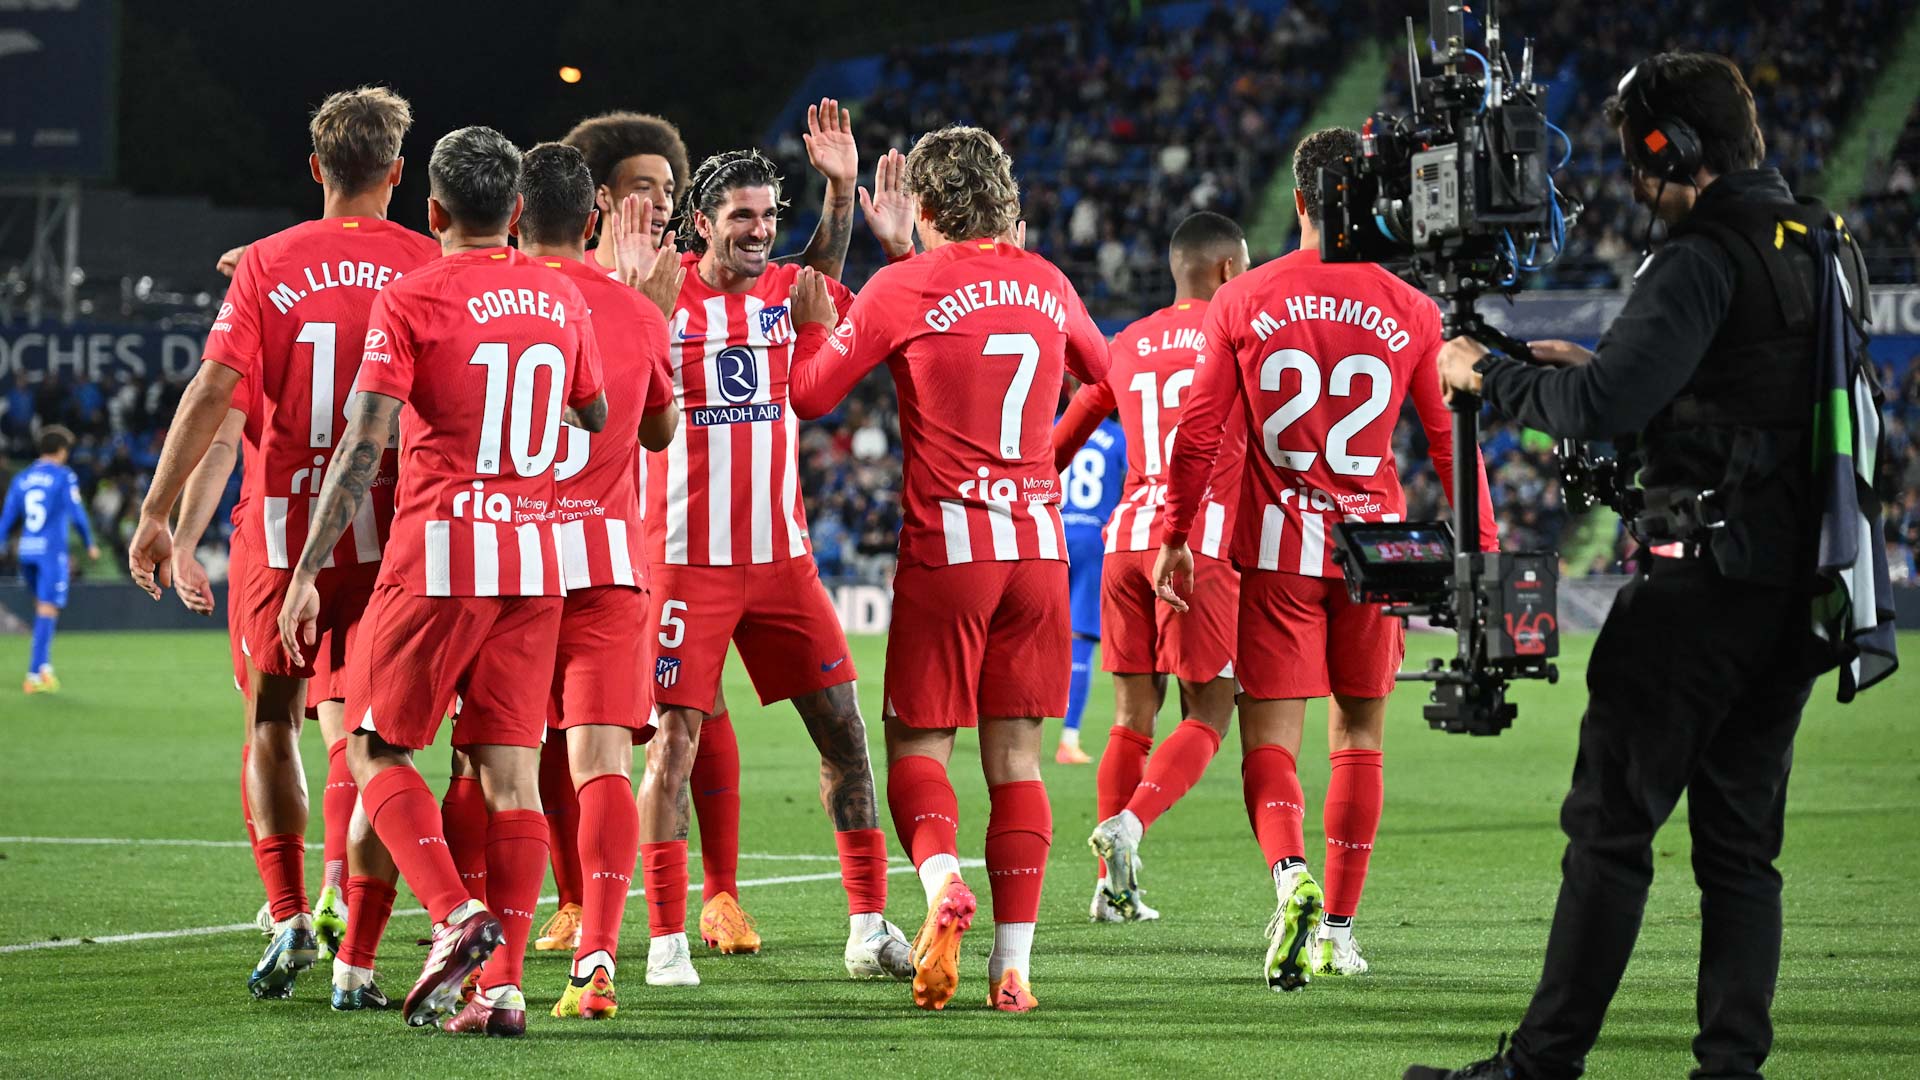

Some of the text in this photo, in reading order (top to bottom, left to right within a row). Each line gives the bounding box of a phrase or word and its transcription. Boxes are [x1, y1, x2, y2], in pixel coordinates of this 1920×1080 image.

[268, 260, 403, 315] M. LLORE
[467, 288, 566, 328] CORREA
[925, 280, 1066, 332] GRIEZMANN
[1250, 295, 1411, 352] M. HERMOSO
[0, 332, 147, 384] CHES
[363, 351, 391, 363] NDAI
[828, 335, 849, 357] NDAI
[1137, 337, 1158, 357] S.
[468, 342, 566, 478] 10
[694, 404, 780, 425] RIYADH AIR
[981, 333, 1040, 460] 7
[1260, 348, 1392, 476] 22
[290, 454, 325, 495] ri
[1022, 477, 1055, 490] Money
[1280, 476, 1336, 512] ria
[24, 488, 47, 533] 5
[453, 480, 512, 523] ria
[516, 495, 548, 513] Money
[658, 599, 688, 649] 5
